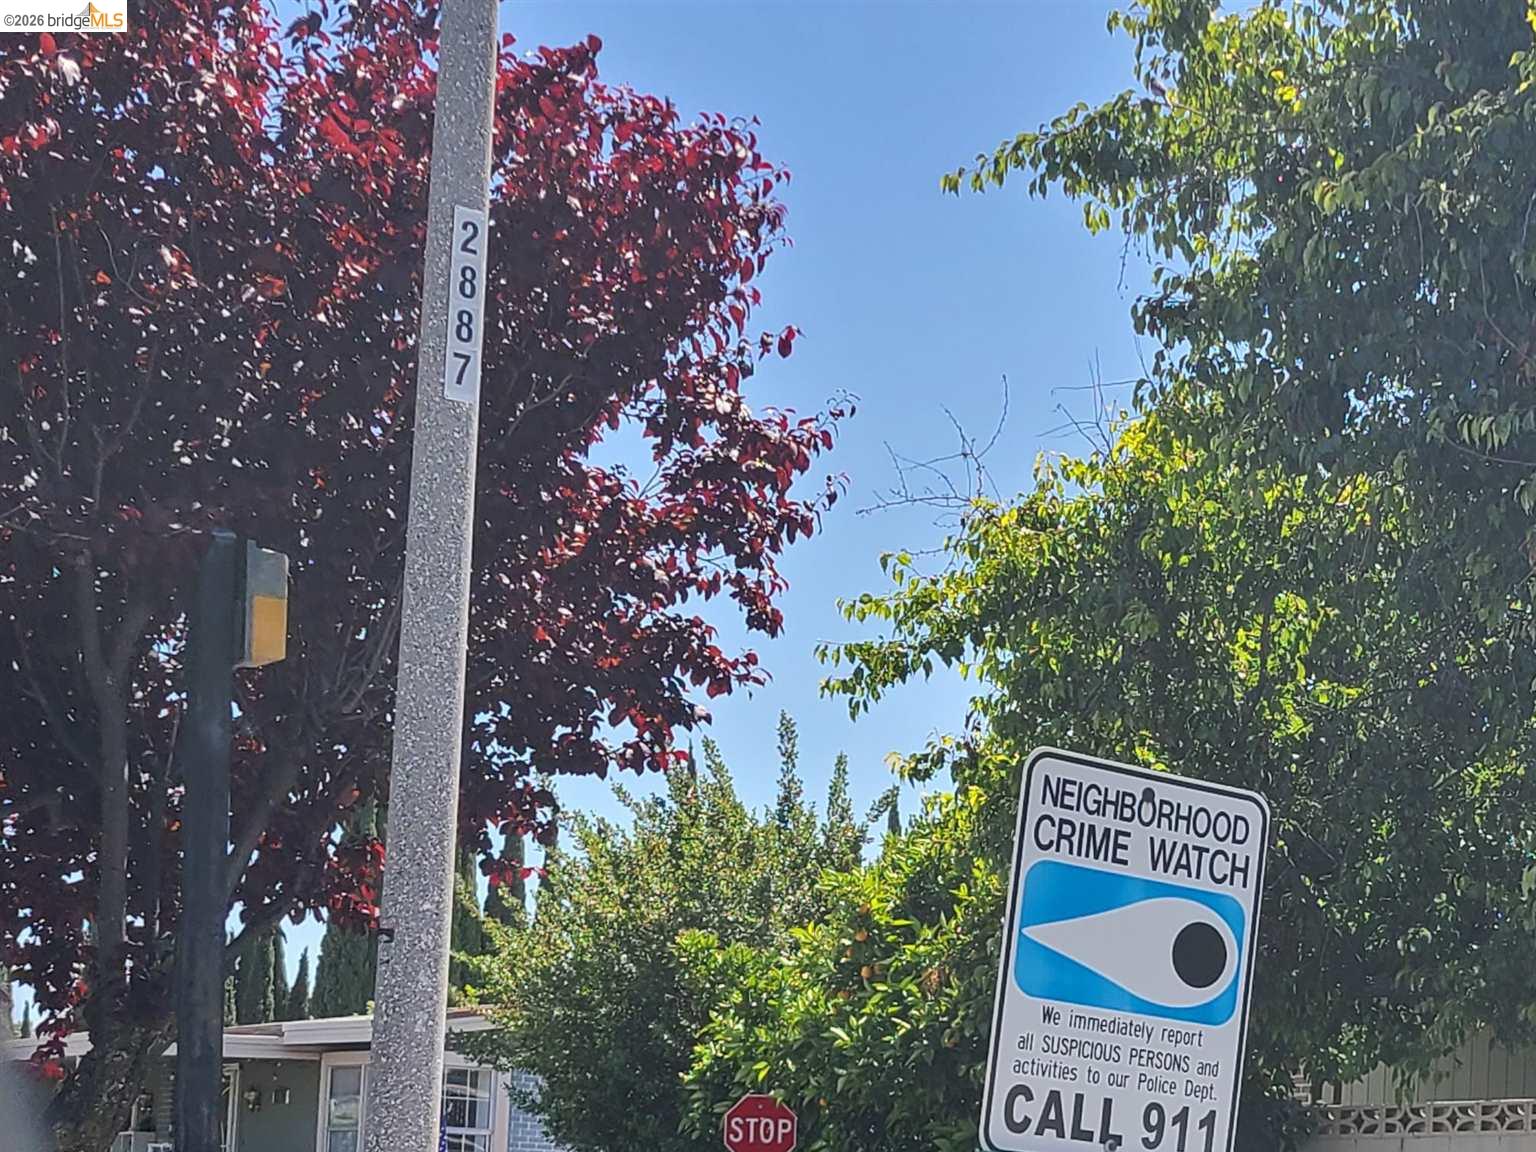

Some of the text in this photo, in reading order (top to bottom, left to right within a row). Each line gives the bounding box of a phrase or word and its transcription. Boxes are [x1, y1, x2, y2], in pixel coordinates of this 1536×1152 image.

[453, 221, 479, 386] 2887
[1041, 774, 1250, 845] NEIGHBORHOOD
[1034, 814, 1251, 889] CRIME WATCH
[1042, 1005, 1203, 1048] We immediately report
[1013, 1059, 1218, 1102] activities to our Police Dept.
[1017, 1033, 1220, 1078] all SUSPICIOUS PERSONS and
[729, 1117, 792, 1144] STOP
[1003, 1083, 1124, 1148] CALL
